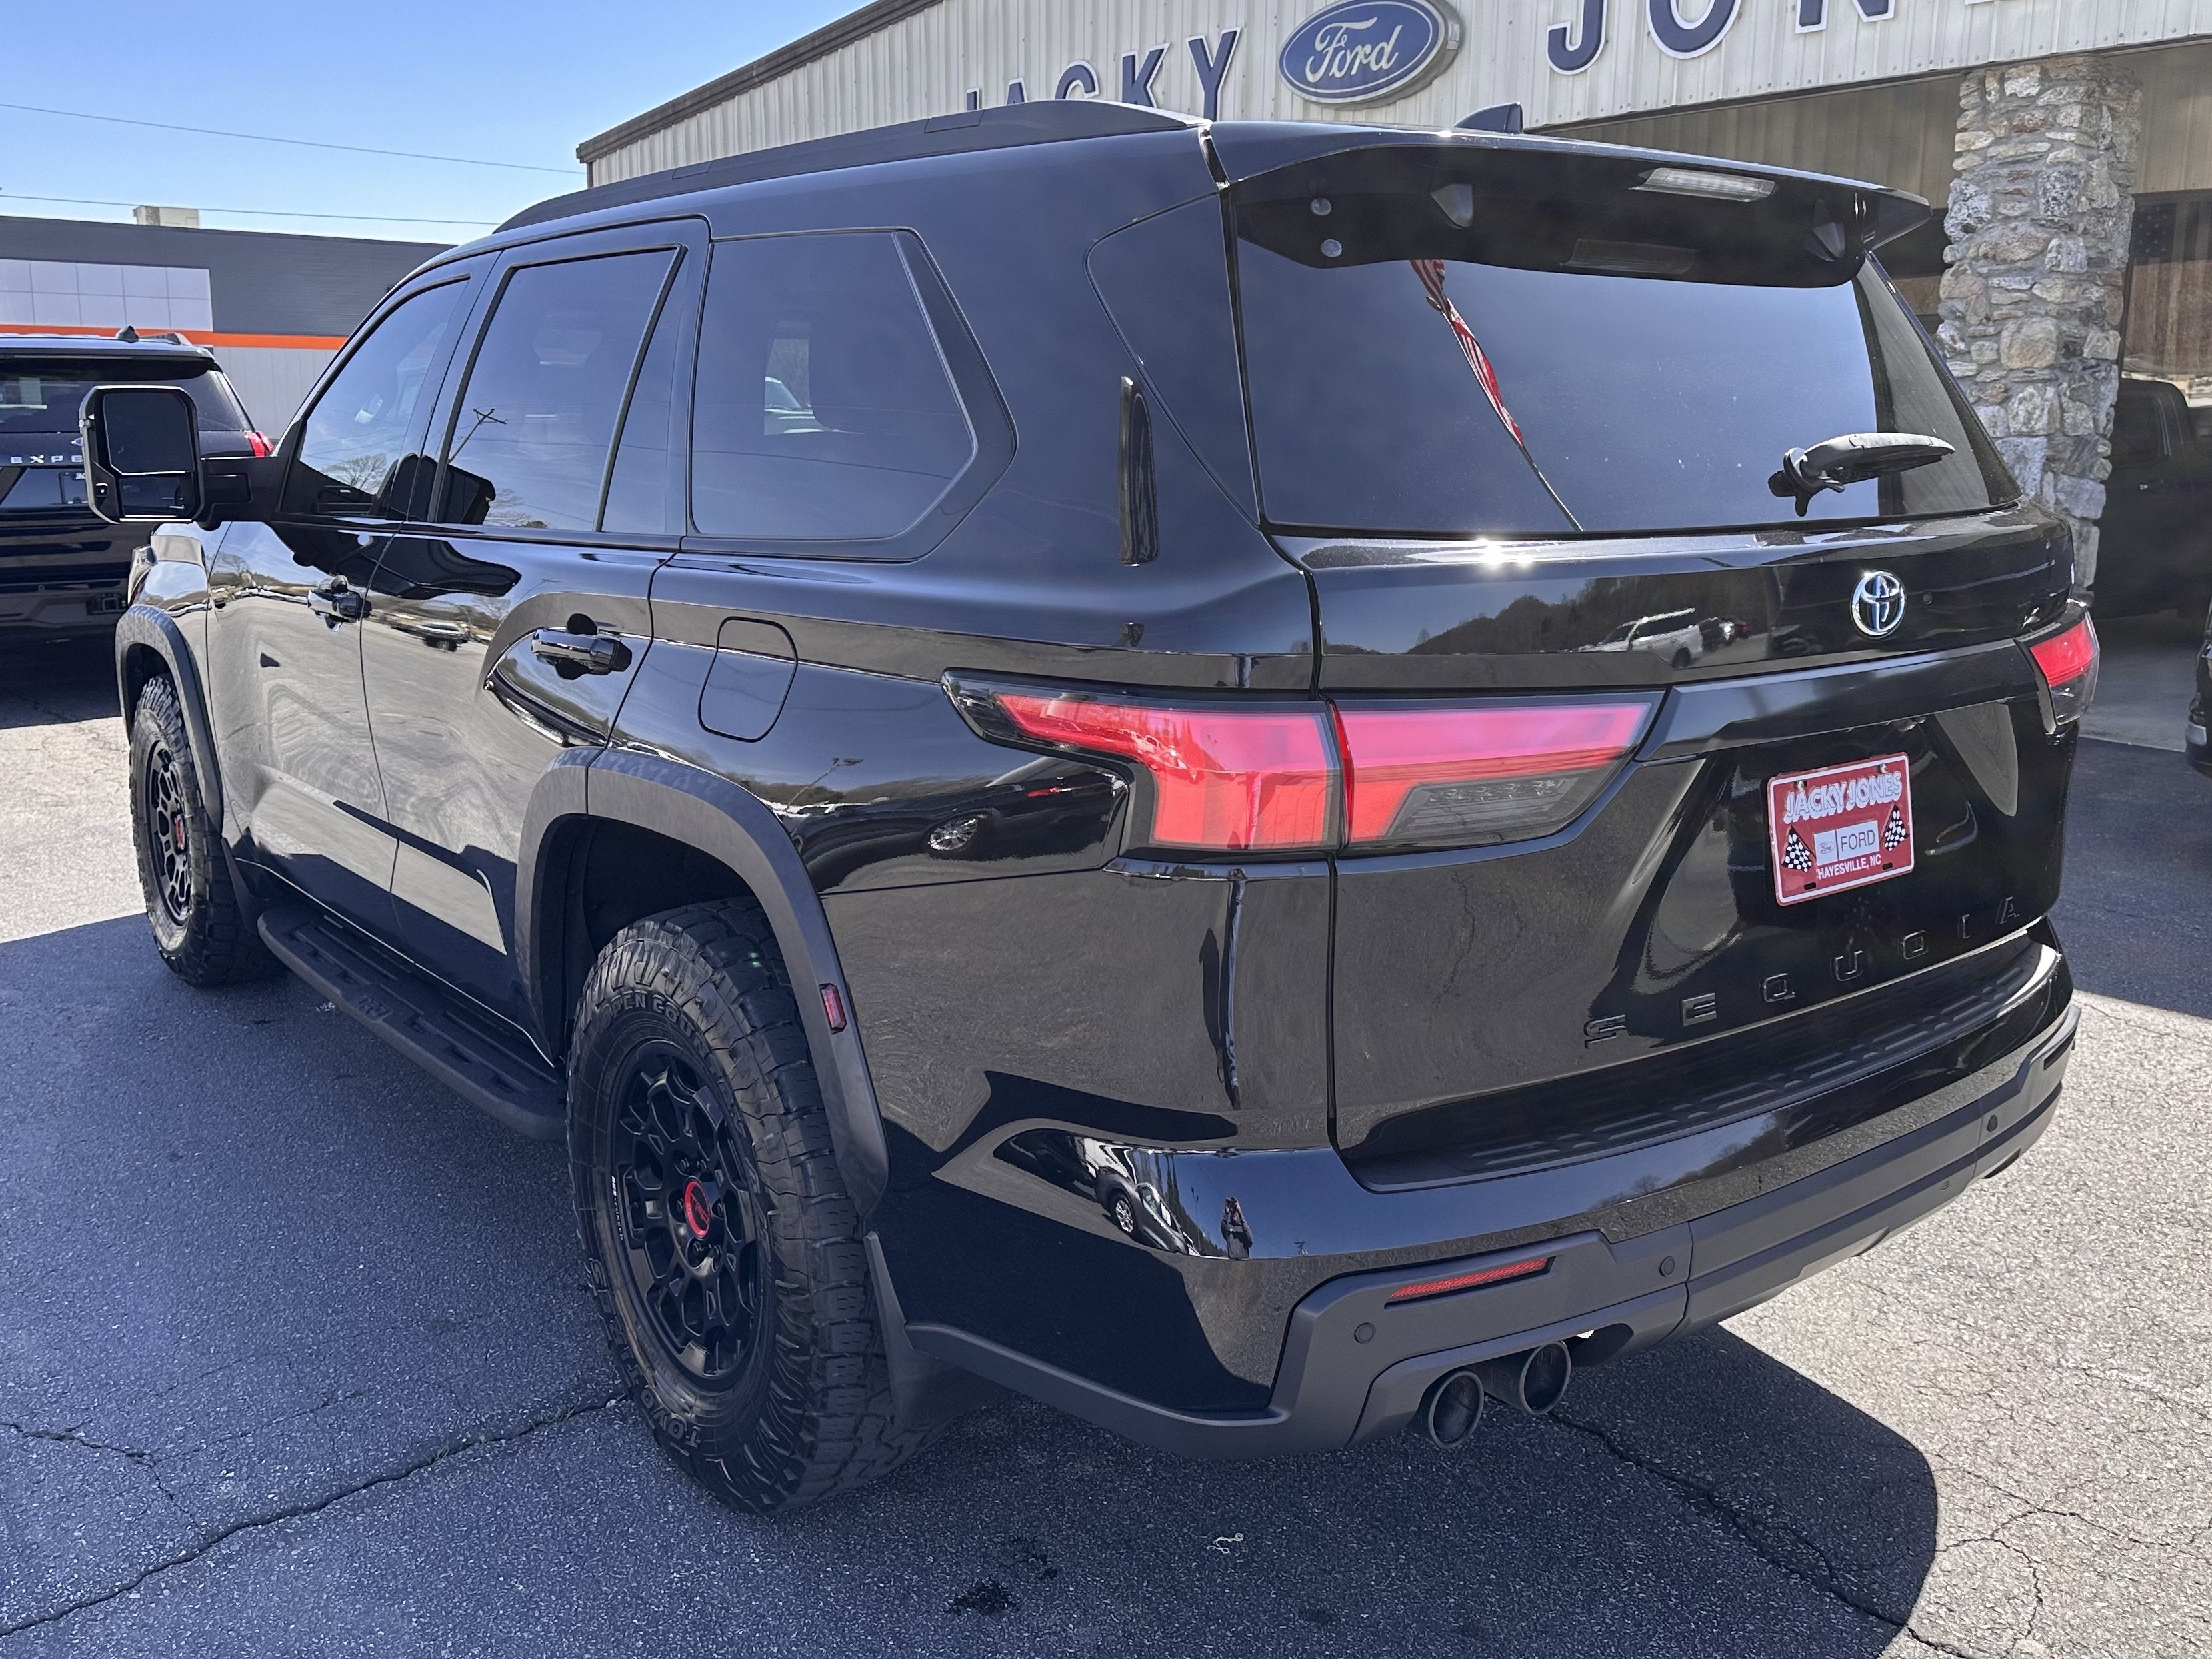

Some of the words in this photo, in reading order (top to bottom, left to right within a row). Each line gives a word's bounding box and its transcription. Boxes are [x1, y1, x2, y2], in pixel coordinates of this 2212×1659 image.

[966, 27, 1241, 121] CKY
[1305, 17, 1403, 84] Ford
[1783, 781, 1847, 825] JACKY
[1845, 771, 1903, 810] JONES
[1816, 858, 1869, 880] HAYESVILLE,
[1869, 854, 1881, 867] NC
[1840, 830, 1875, 852] FORD
[1583, 896, 2020, 1049] SEQUOIA
[640, 1385, 700, 1448] TOYO
